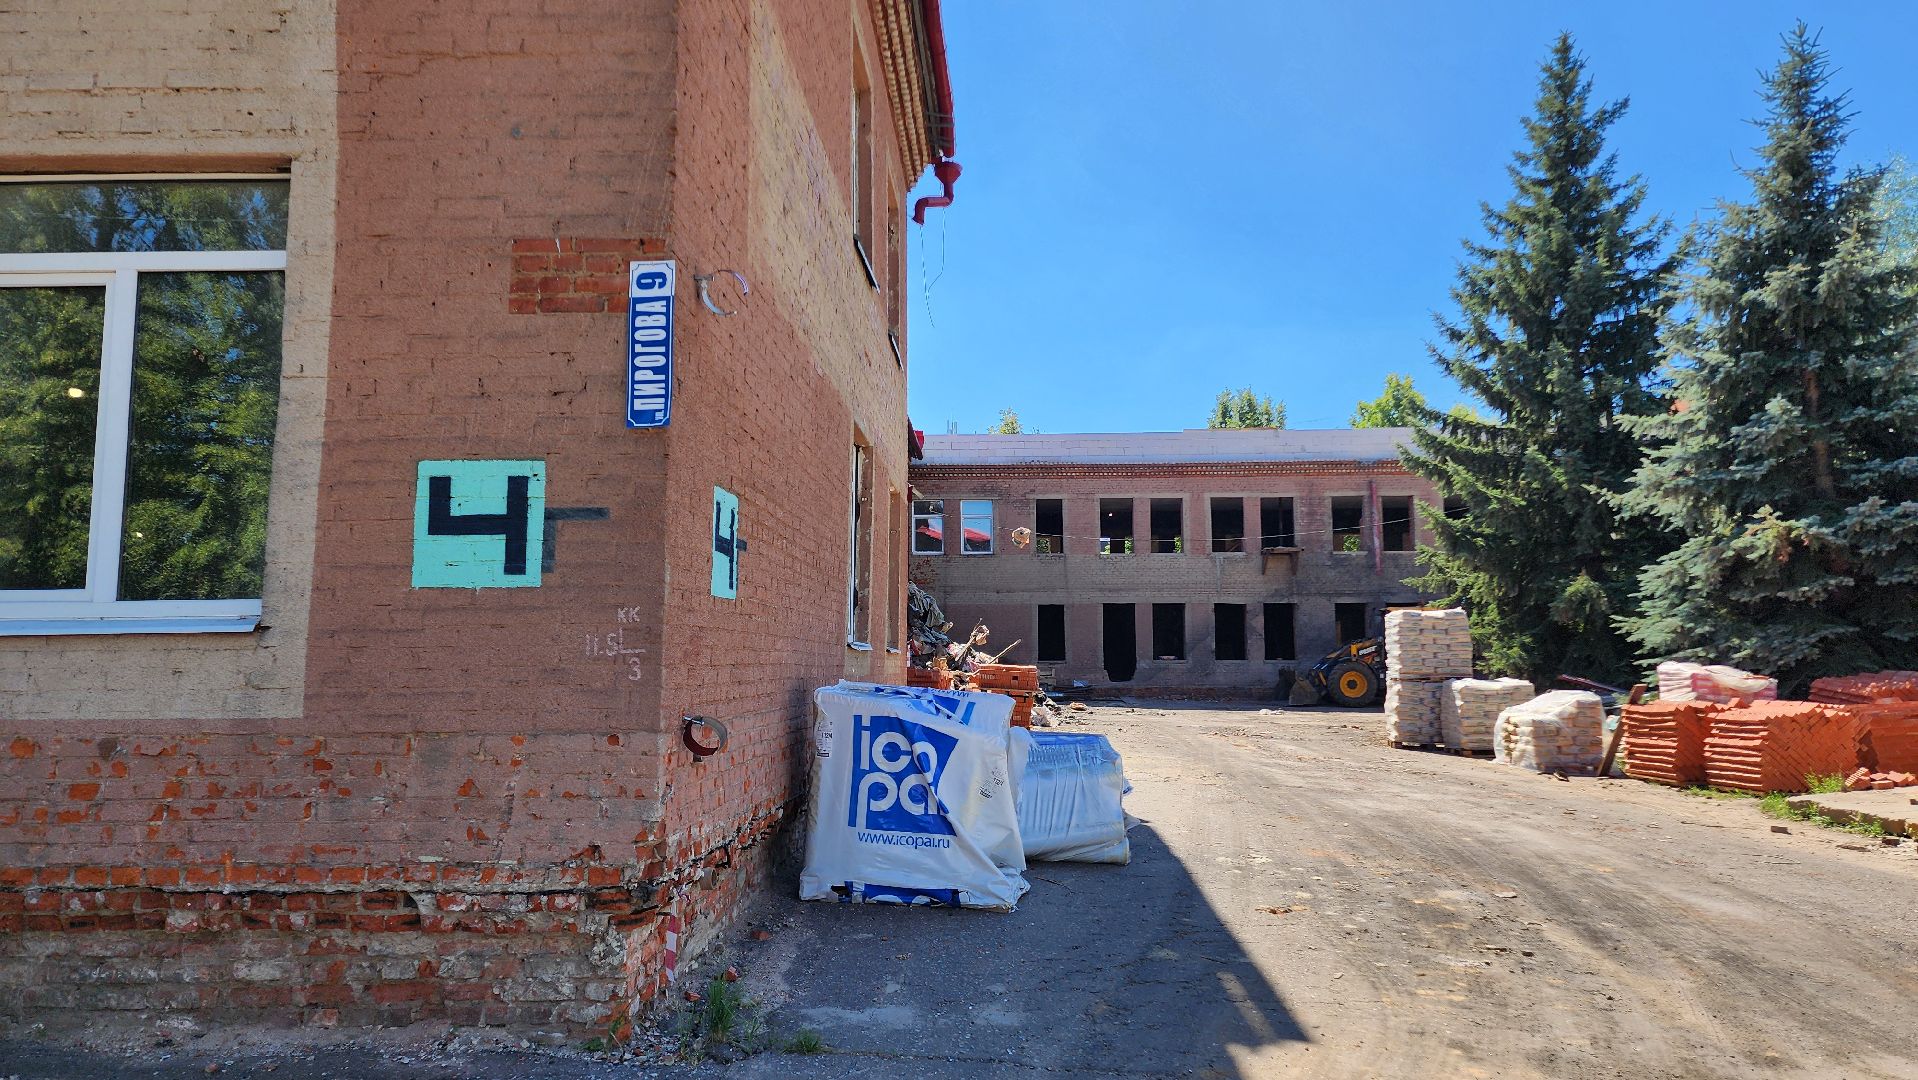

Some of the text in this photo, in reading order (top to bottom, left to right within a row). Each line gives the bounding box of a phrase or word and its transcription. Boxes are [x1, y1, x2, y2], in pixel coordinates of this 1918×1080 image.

[636, 272, 667, 290] 9
[633, 300, 667, 411] ПИРОГОВА
[857, 772, 950, 829] pa
